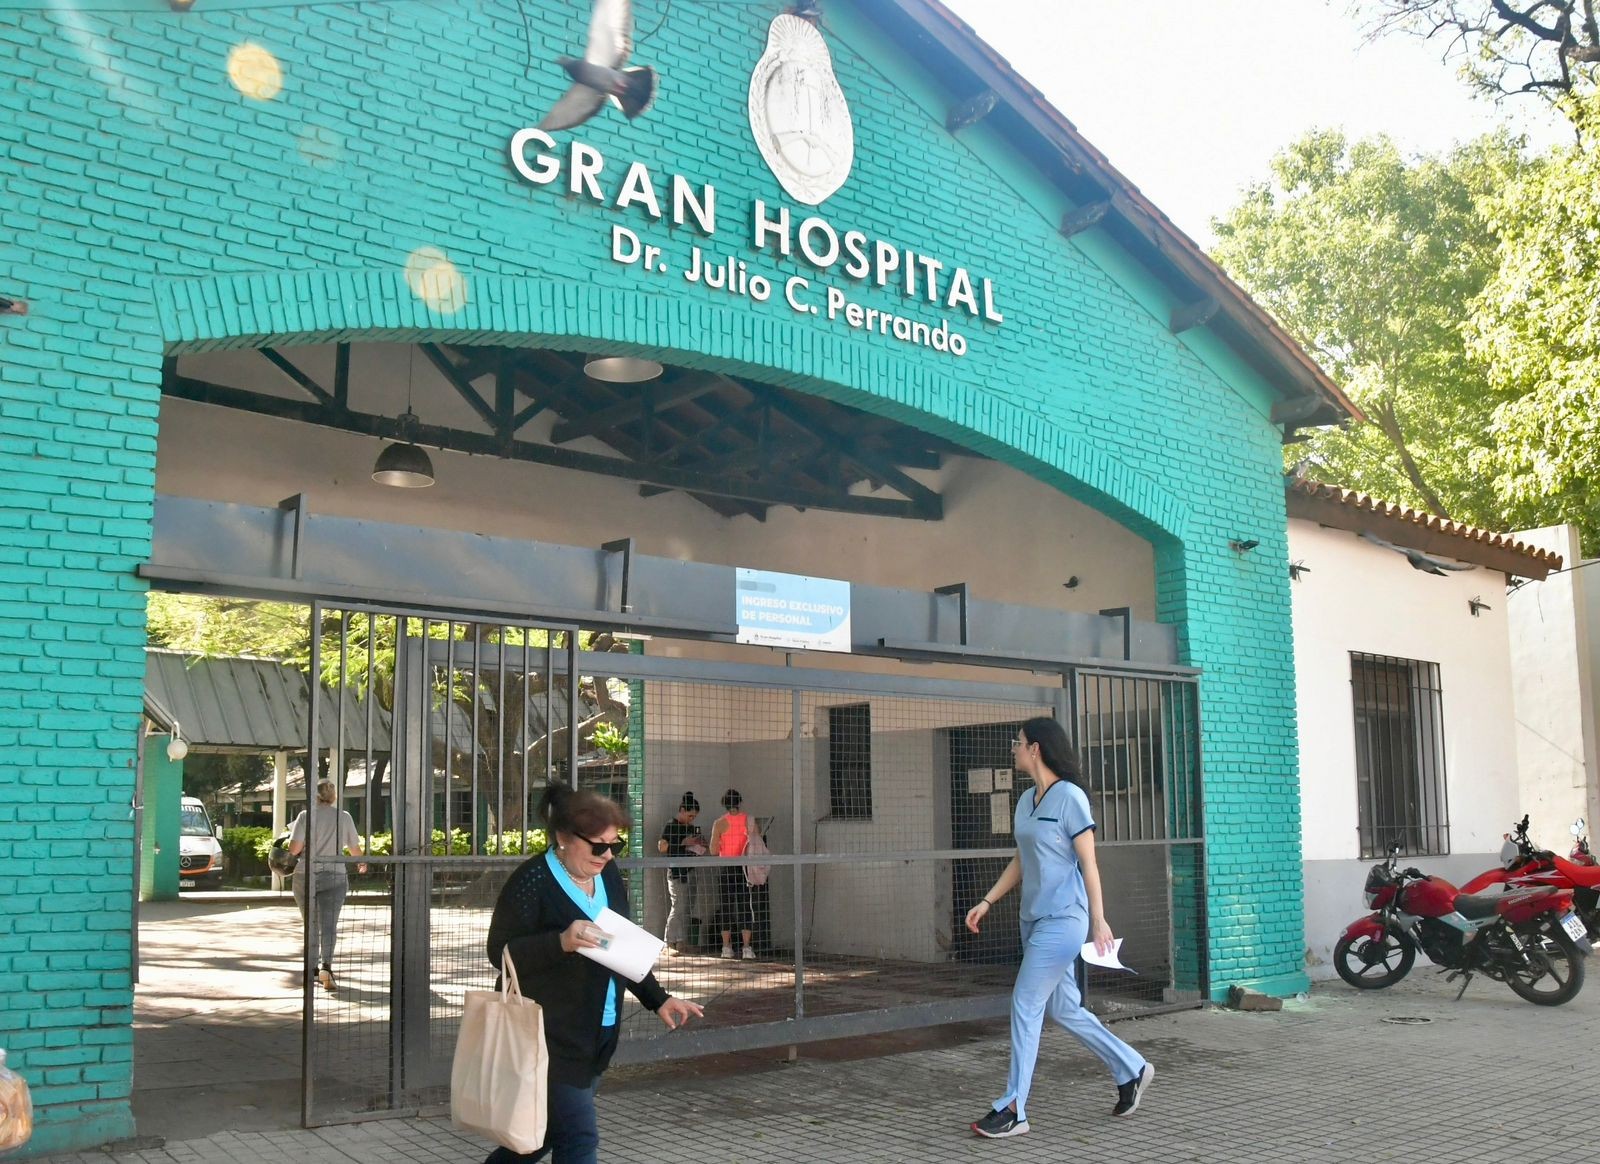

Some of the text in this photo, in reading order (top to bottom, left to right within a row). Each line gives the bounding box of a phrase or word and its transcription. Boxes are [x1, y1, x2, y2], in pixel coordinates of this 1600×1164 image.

[509, 127, 1004, 323] GRAN HOSPITAL
[611, 225, 967, 357] Dr. Julio C. Perrando
[741, 610, 812, 626] DE PERSONAL
[742, 596, 844, 615] INGRESO EXCLUSIVO
